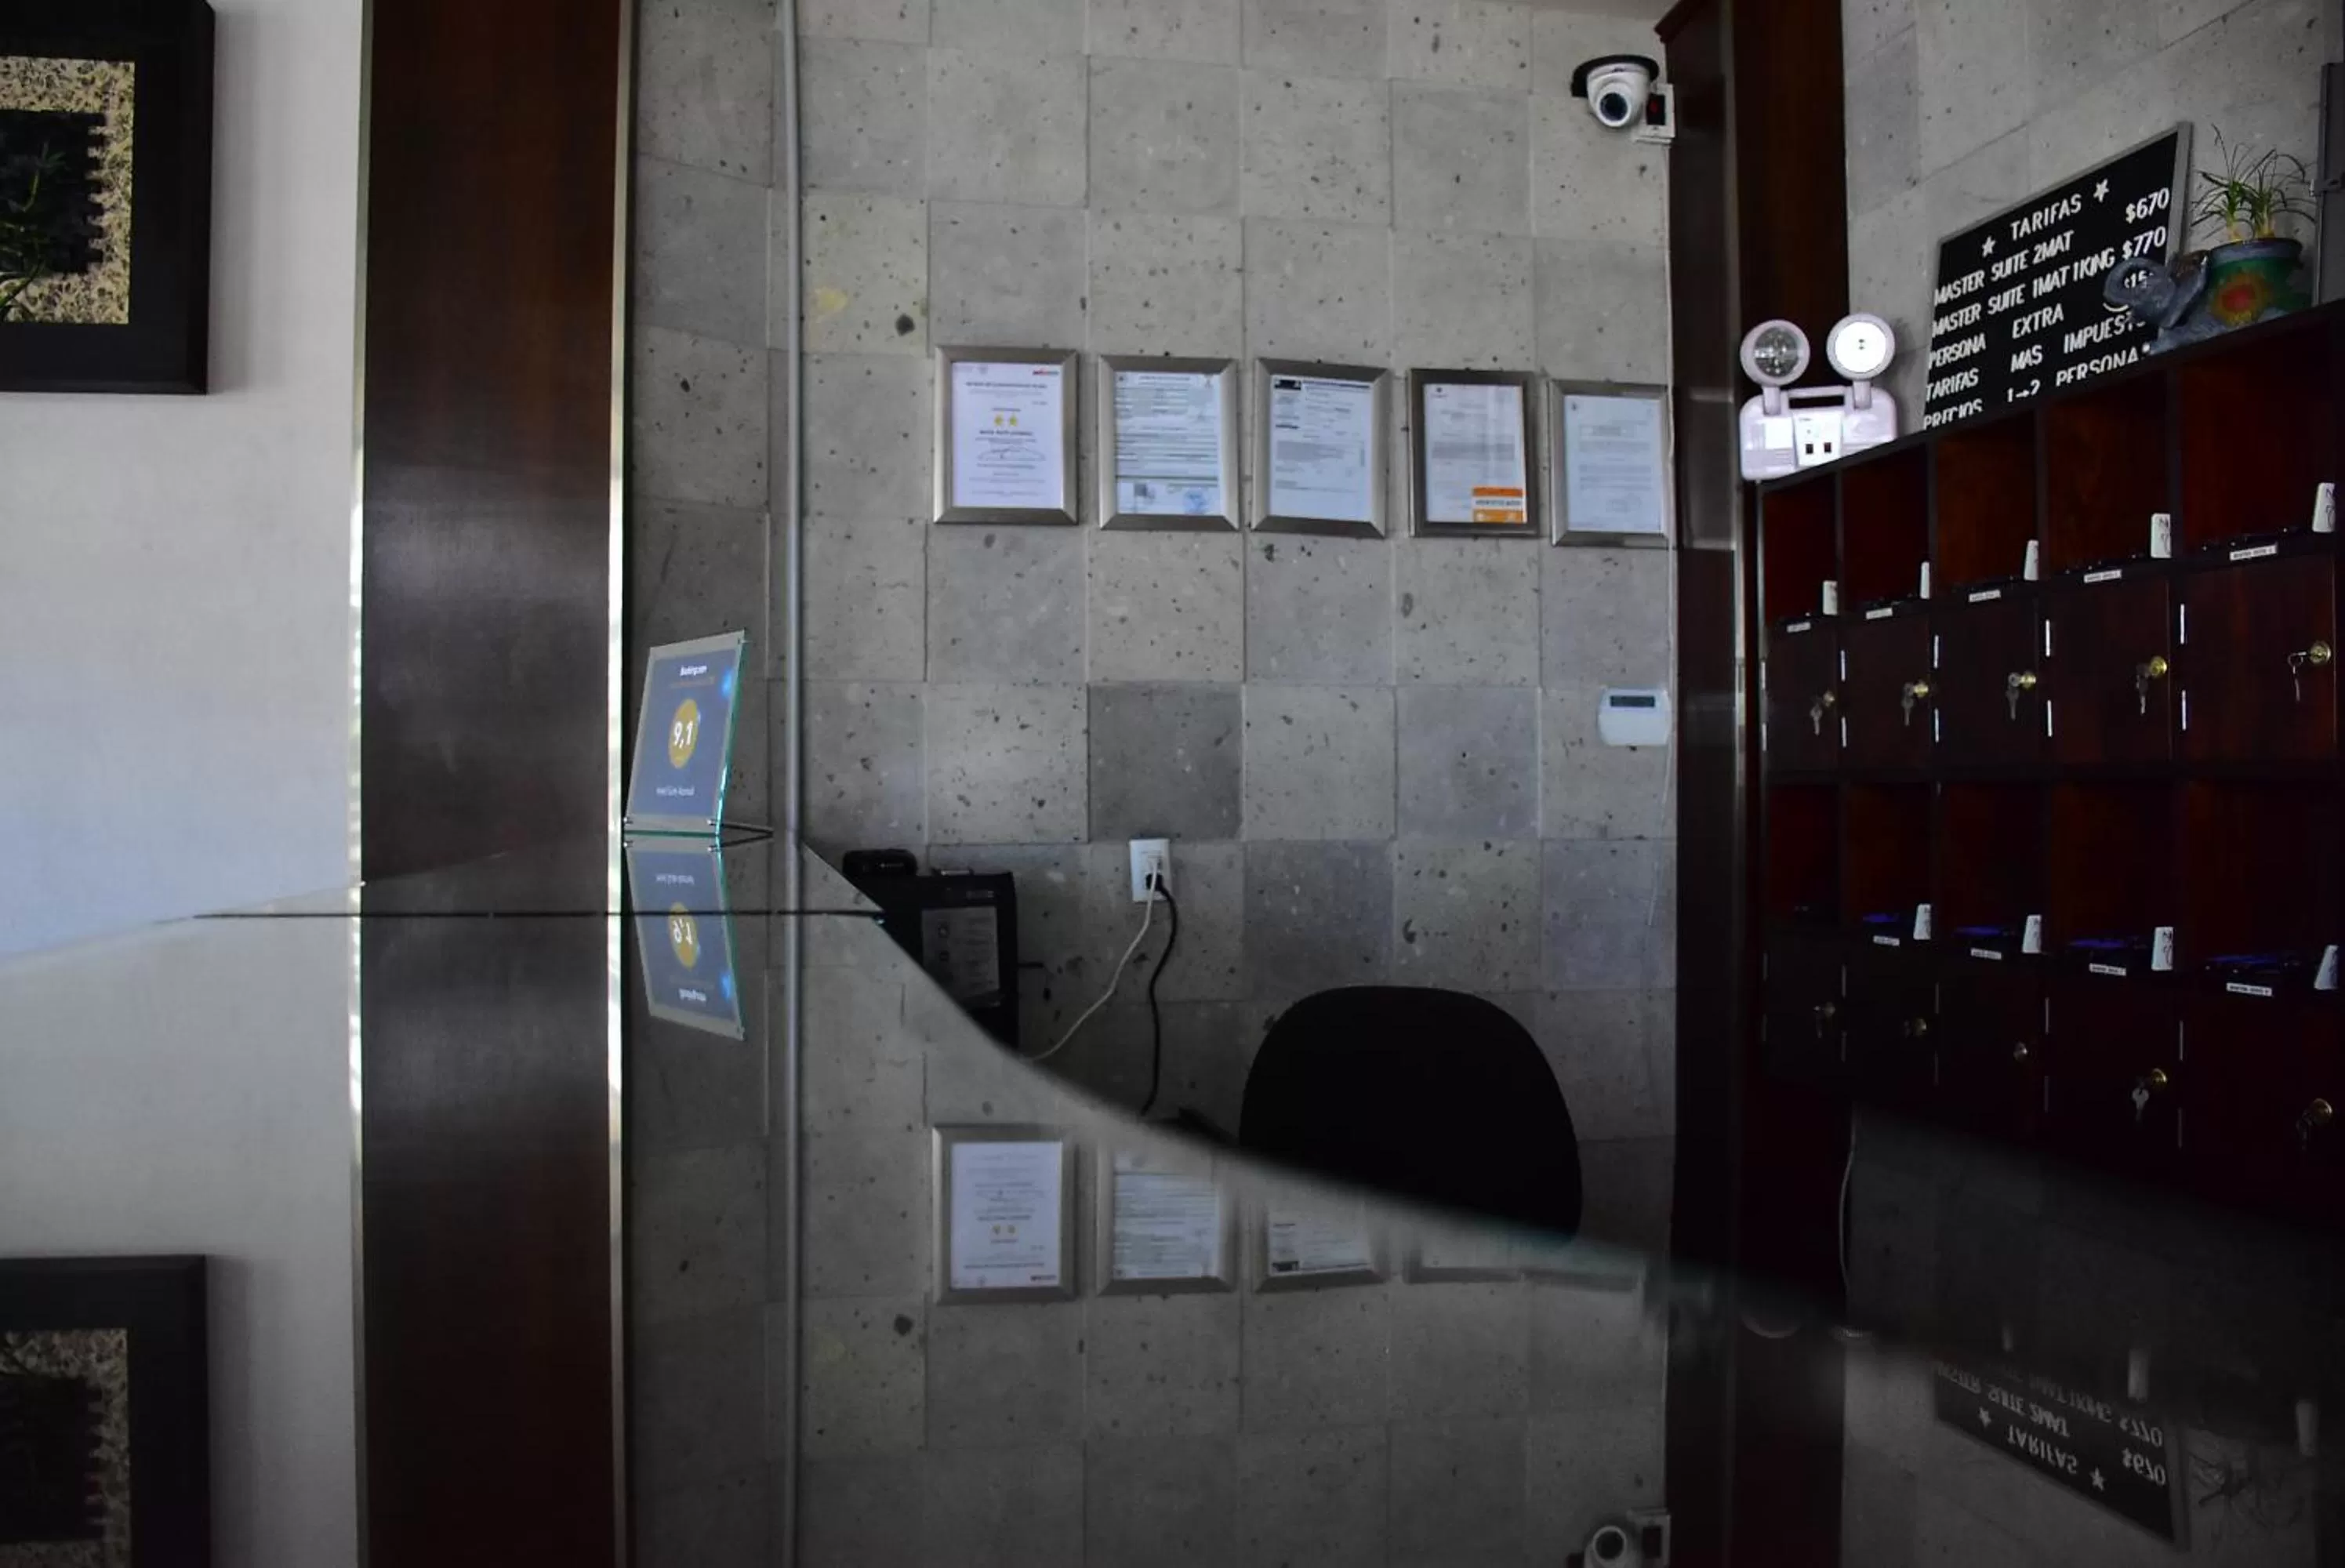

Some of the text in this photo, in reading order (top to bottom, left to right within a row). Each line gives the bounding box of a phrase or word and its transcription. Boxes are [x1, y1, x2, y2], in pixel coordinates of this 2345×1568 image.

[1933, 187, 2169, 306] MASTER SUITE 2MAT $670
[2010, 194, 2082, 241] TARIFAS
[1932, 303, 1981, 338] MASTER
[1987, 284, 2026, 314] SUITE
[2122, 226, 2166, 260] $770
[1929, 332, 1986, 370] PERSONA
[2012, 303, 2064, 339] EXTRA
[1926, 368, 1980, 402] TARIFAS
[2010, 345, 2043, 372] MAS
